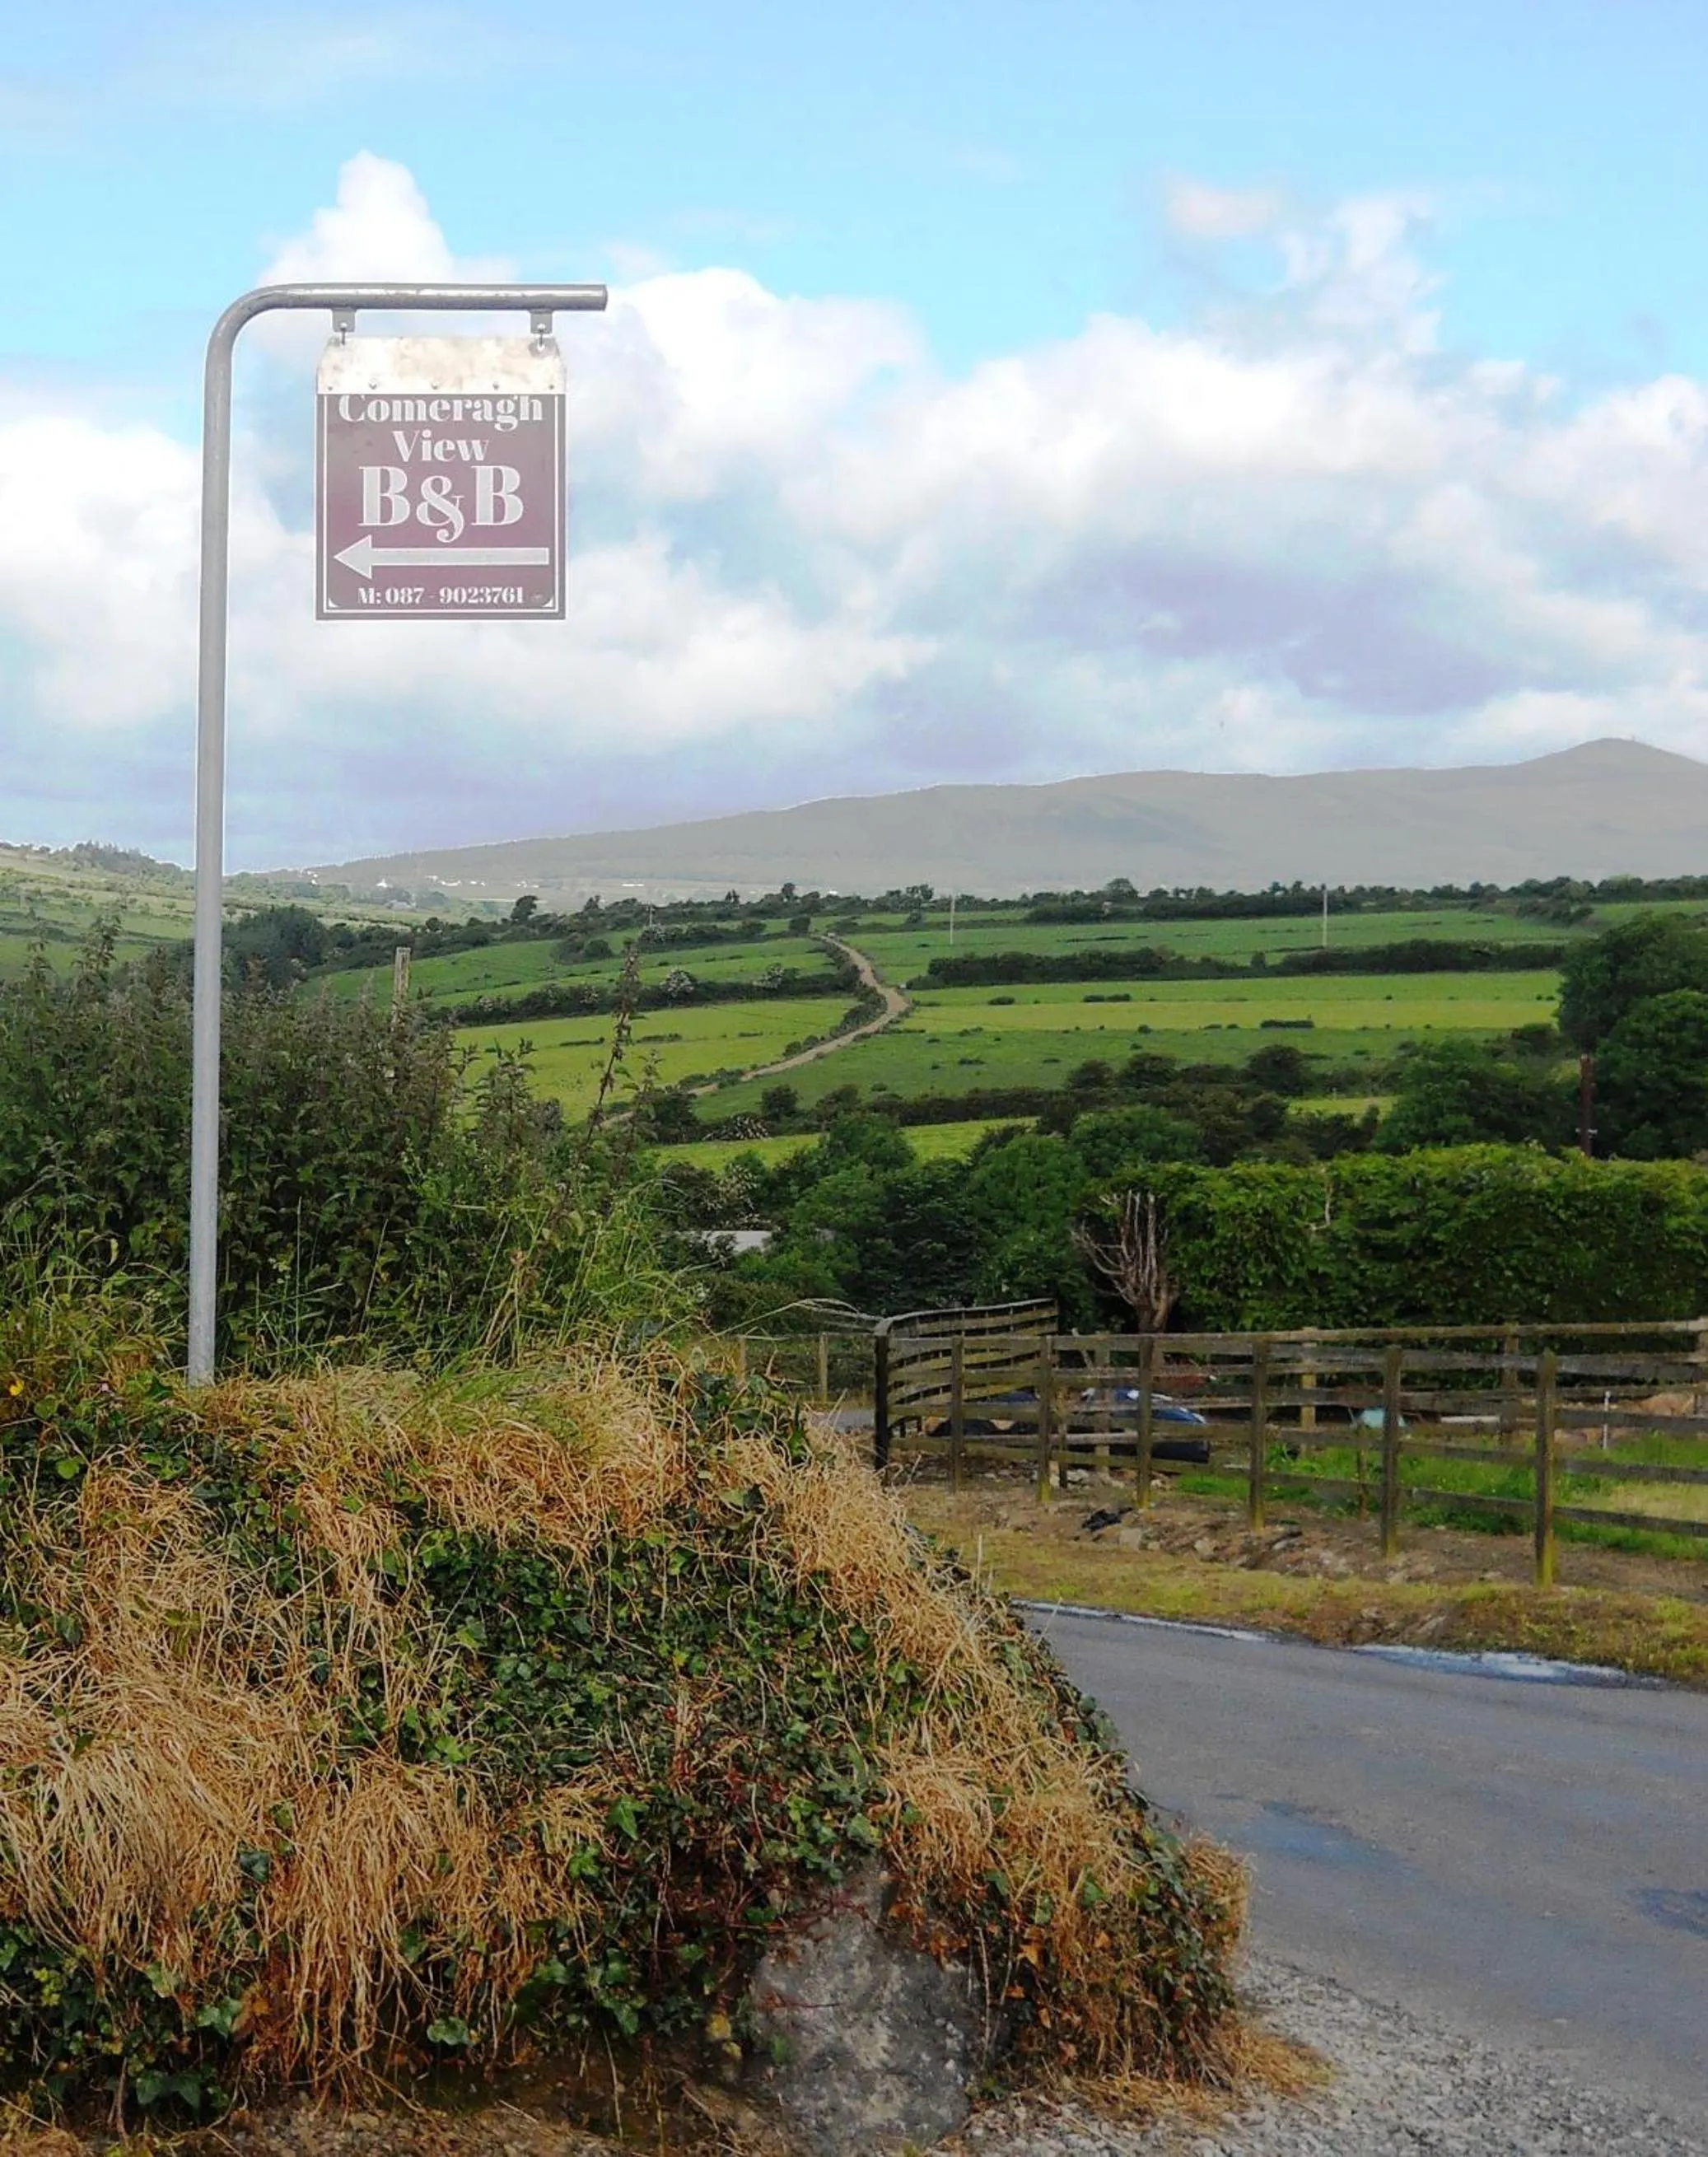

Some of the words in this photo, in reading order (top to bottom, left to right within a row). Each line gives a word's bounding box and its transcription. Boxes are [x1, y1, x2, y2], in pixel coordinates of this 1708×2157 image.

[338, 395, 544, 432] Comeragh
[392, 429, 490, 462] View
[357, 465, 524, 543] B&B
[439, 587, 524, 605] 9023761
